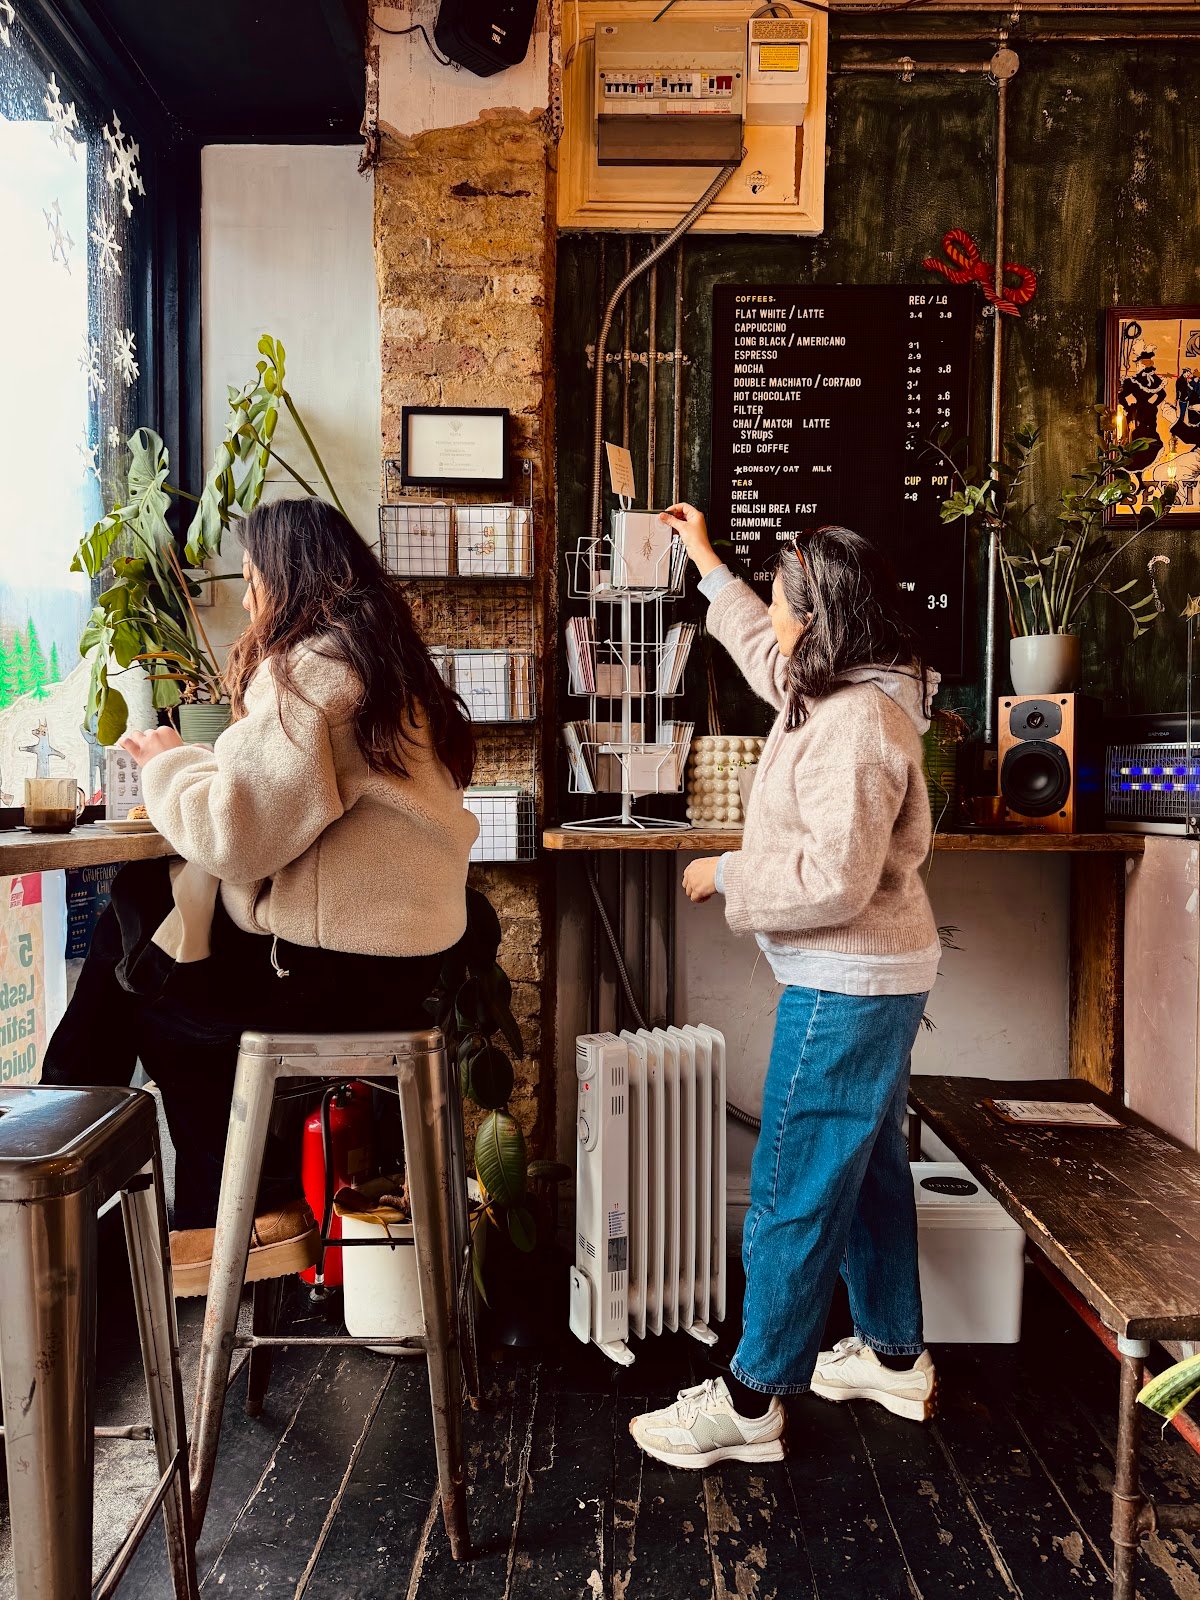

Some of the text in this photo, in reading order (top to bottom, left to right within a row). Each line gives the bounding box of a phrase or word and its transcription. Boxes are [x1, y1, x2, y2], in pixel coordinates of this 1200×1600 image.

[909, 296, 925, 305] REG
[936, 296, 947, 304] LG
[736, 309, 756, 318] FLAT
[760, 309, 786, 318] WHITE
[798, 309, 824, 318] LATTE
[735, 323, 786, 332] CAPPUCCINO
[735, 337, 756, 346] LONG
[759, 337, 786, 346] BLACK
[797, 336, 845, 346] AMERICANO
[735, 350, 777, 360] ESPRESSO
[734, 364, 764, 373] MOCHA
[938, 364, 951, 373] 3.8
[734, 378, 766, 387] DOUBLE
[769, 378, 812, 387] MACHIATO
[823, 377, 861, 387] CORTADO
[734, 392, 750, 401] HOT
[753, 391, 801, 401] CHOCOLATE
[938, 391, 950, 400] 3.6
[734, 405, 763, 414] FILTER
[733, 419, 752, 428] CHAI
[763, 419, 792, 428] MATCH
[803, 419, 830, 428] LATTE
[733, 443, 751, 454] ICED
[757, 444, 789, 453] COFFEE
[905, 476, 921, 485] CUP
[932, 476, 948, 485] POT
[732, 490, 758, 500] GREEN
[731, 504, 817, 513] ENGLISH BREA FAST
[731, 518, 781, 527] CHAMOMILE
[731, 531, 760, 541] LEMON
